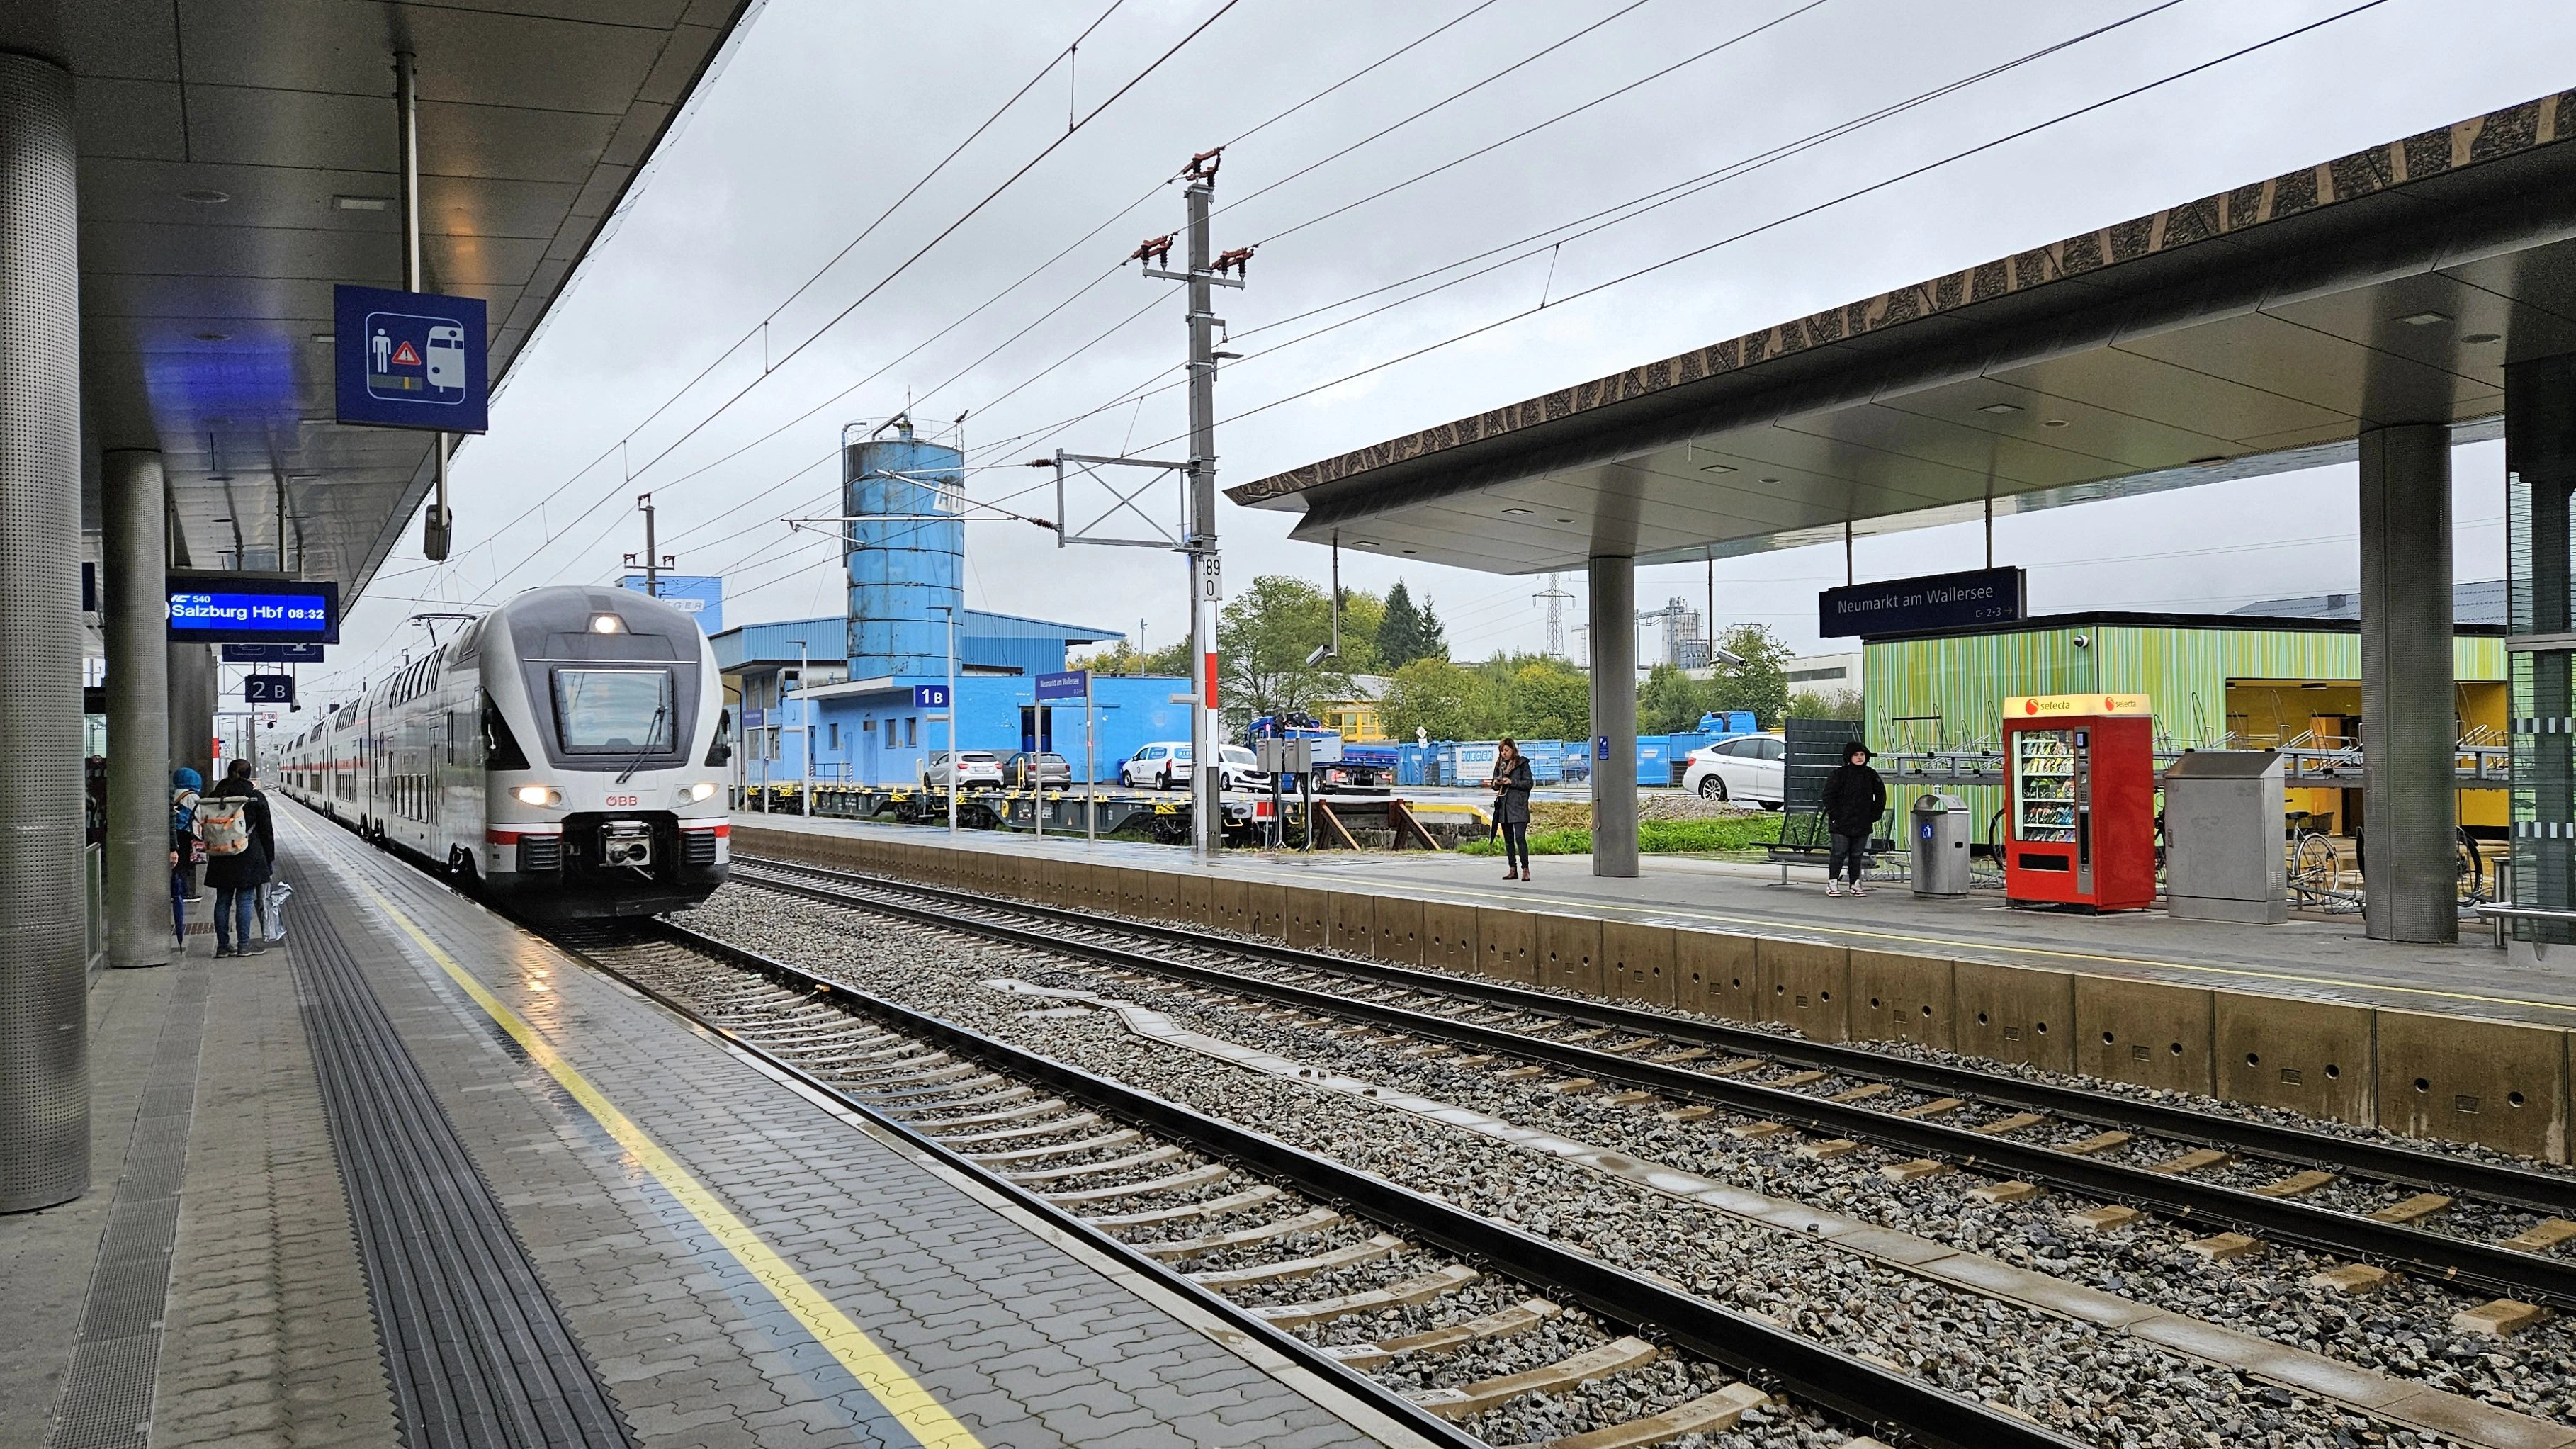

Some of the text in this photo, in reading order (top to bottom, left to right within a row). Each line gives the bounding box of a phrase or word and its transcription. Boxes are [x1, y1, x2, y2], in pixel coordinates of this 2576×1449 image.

[1207, 580, 1214, 596] 0
[1838, 587, 1993, 614] Neumarkt am Wallersee
[171, 604, 324, 621] Salzburg Hbf 08:32
[1987, 607, 2001, 617] 2-3
[252, 681, 286, 699] 2 B
[922, 689, 943, 704] 1 B
[2040, 701, 2070, 710] selecta
[1462, 751, 1493, 762] RIEGER
[606, 796, 638, 806] ÖBB
